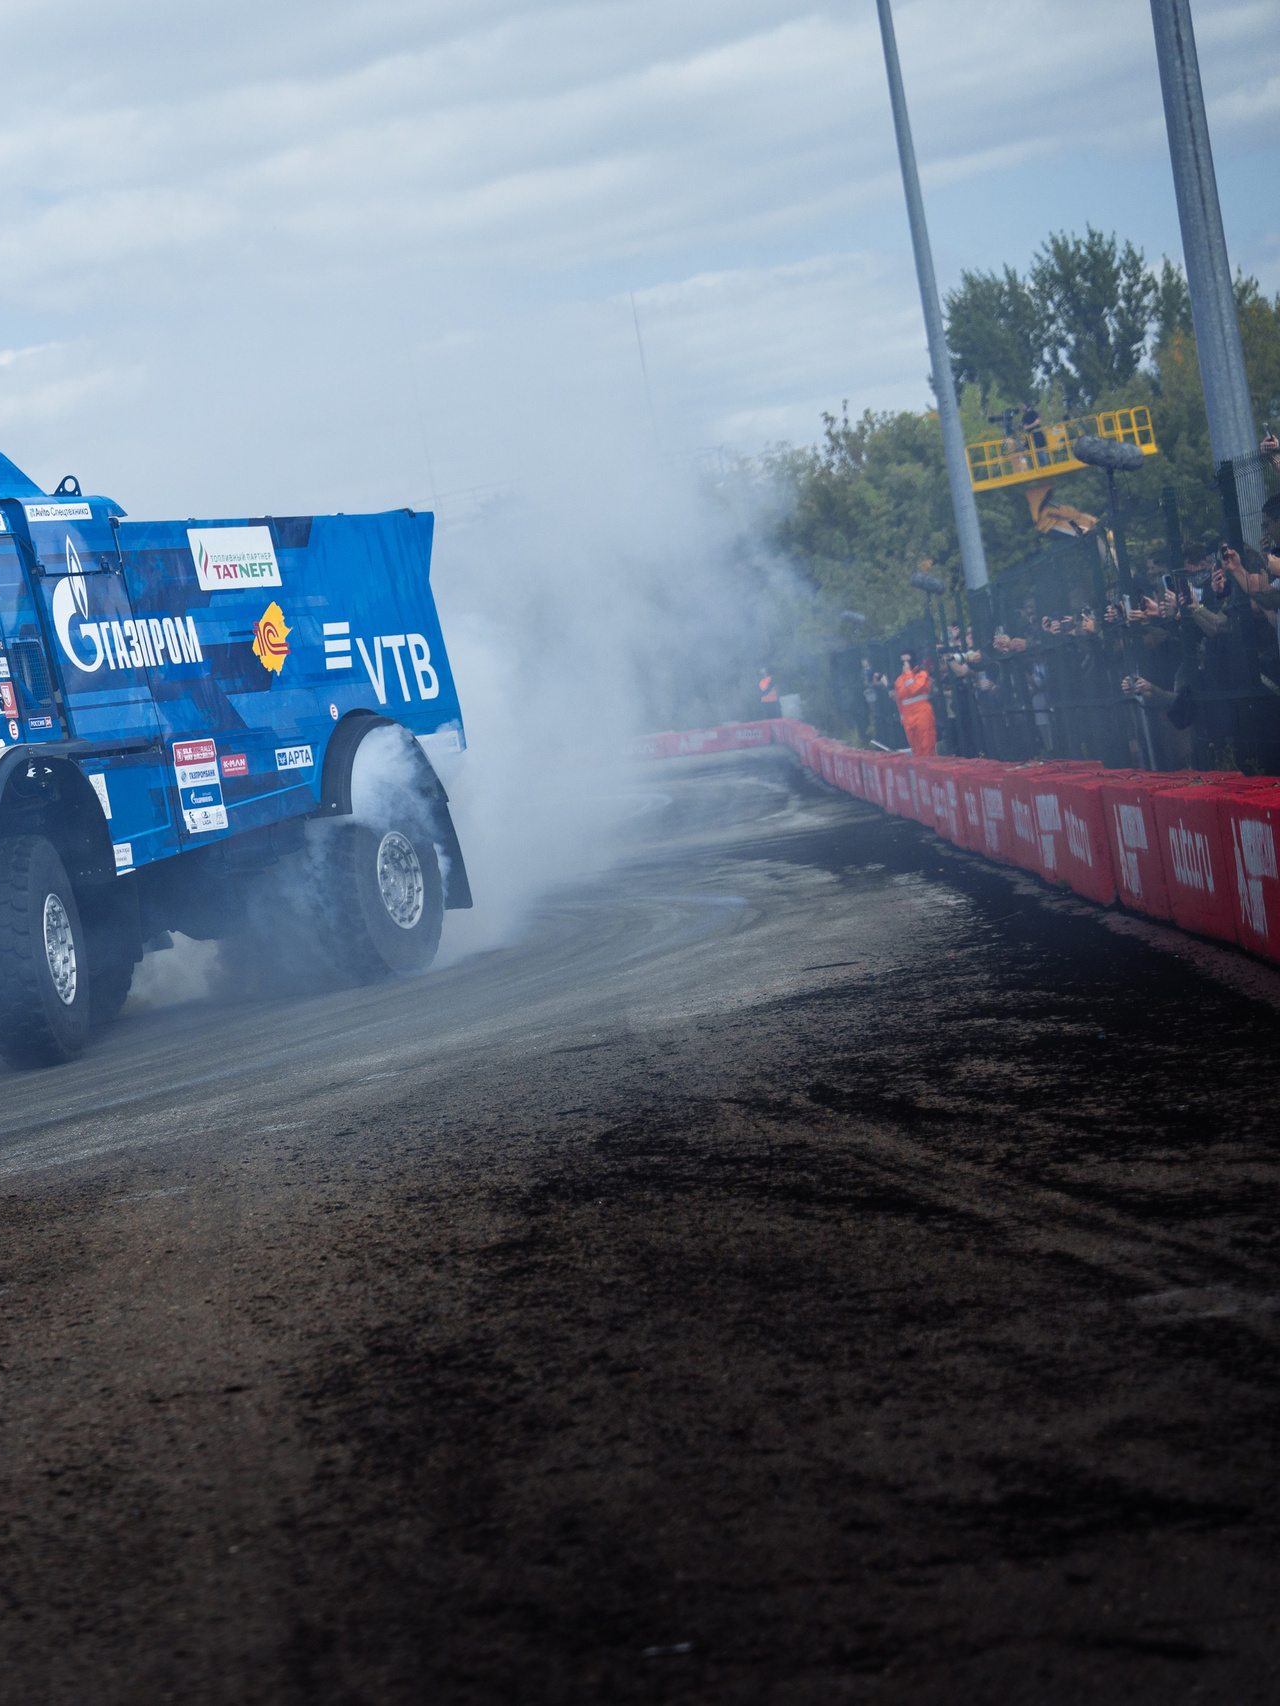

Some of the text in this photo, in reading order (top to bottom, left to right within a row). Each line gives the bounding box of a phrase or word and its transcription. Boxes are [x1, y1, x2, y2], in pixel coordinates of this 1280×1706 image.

[35, 507, 50, 517] Avito
[210, 552, 271, 562] ТОПЛИВНЫЙ ПАРТНЕР
[213, 562, 273, 579] TATNEFT
[99, 616, 204, 670] ГАЗПРОМ
[355, 633, 440, 705] VTB
[1169, 818, 1216, 893] auto.ru
